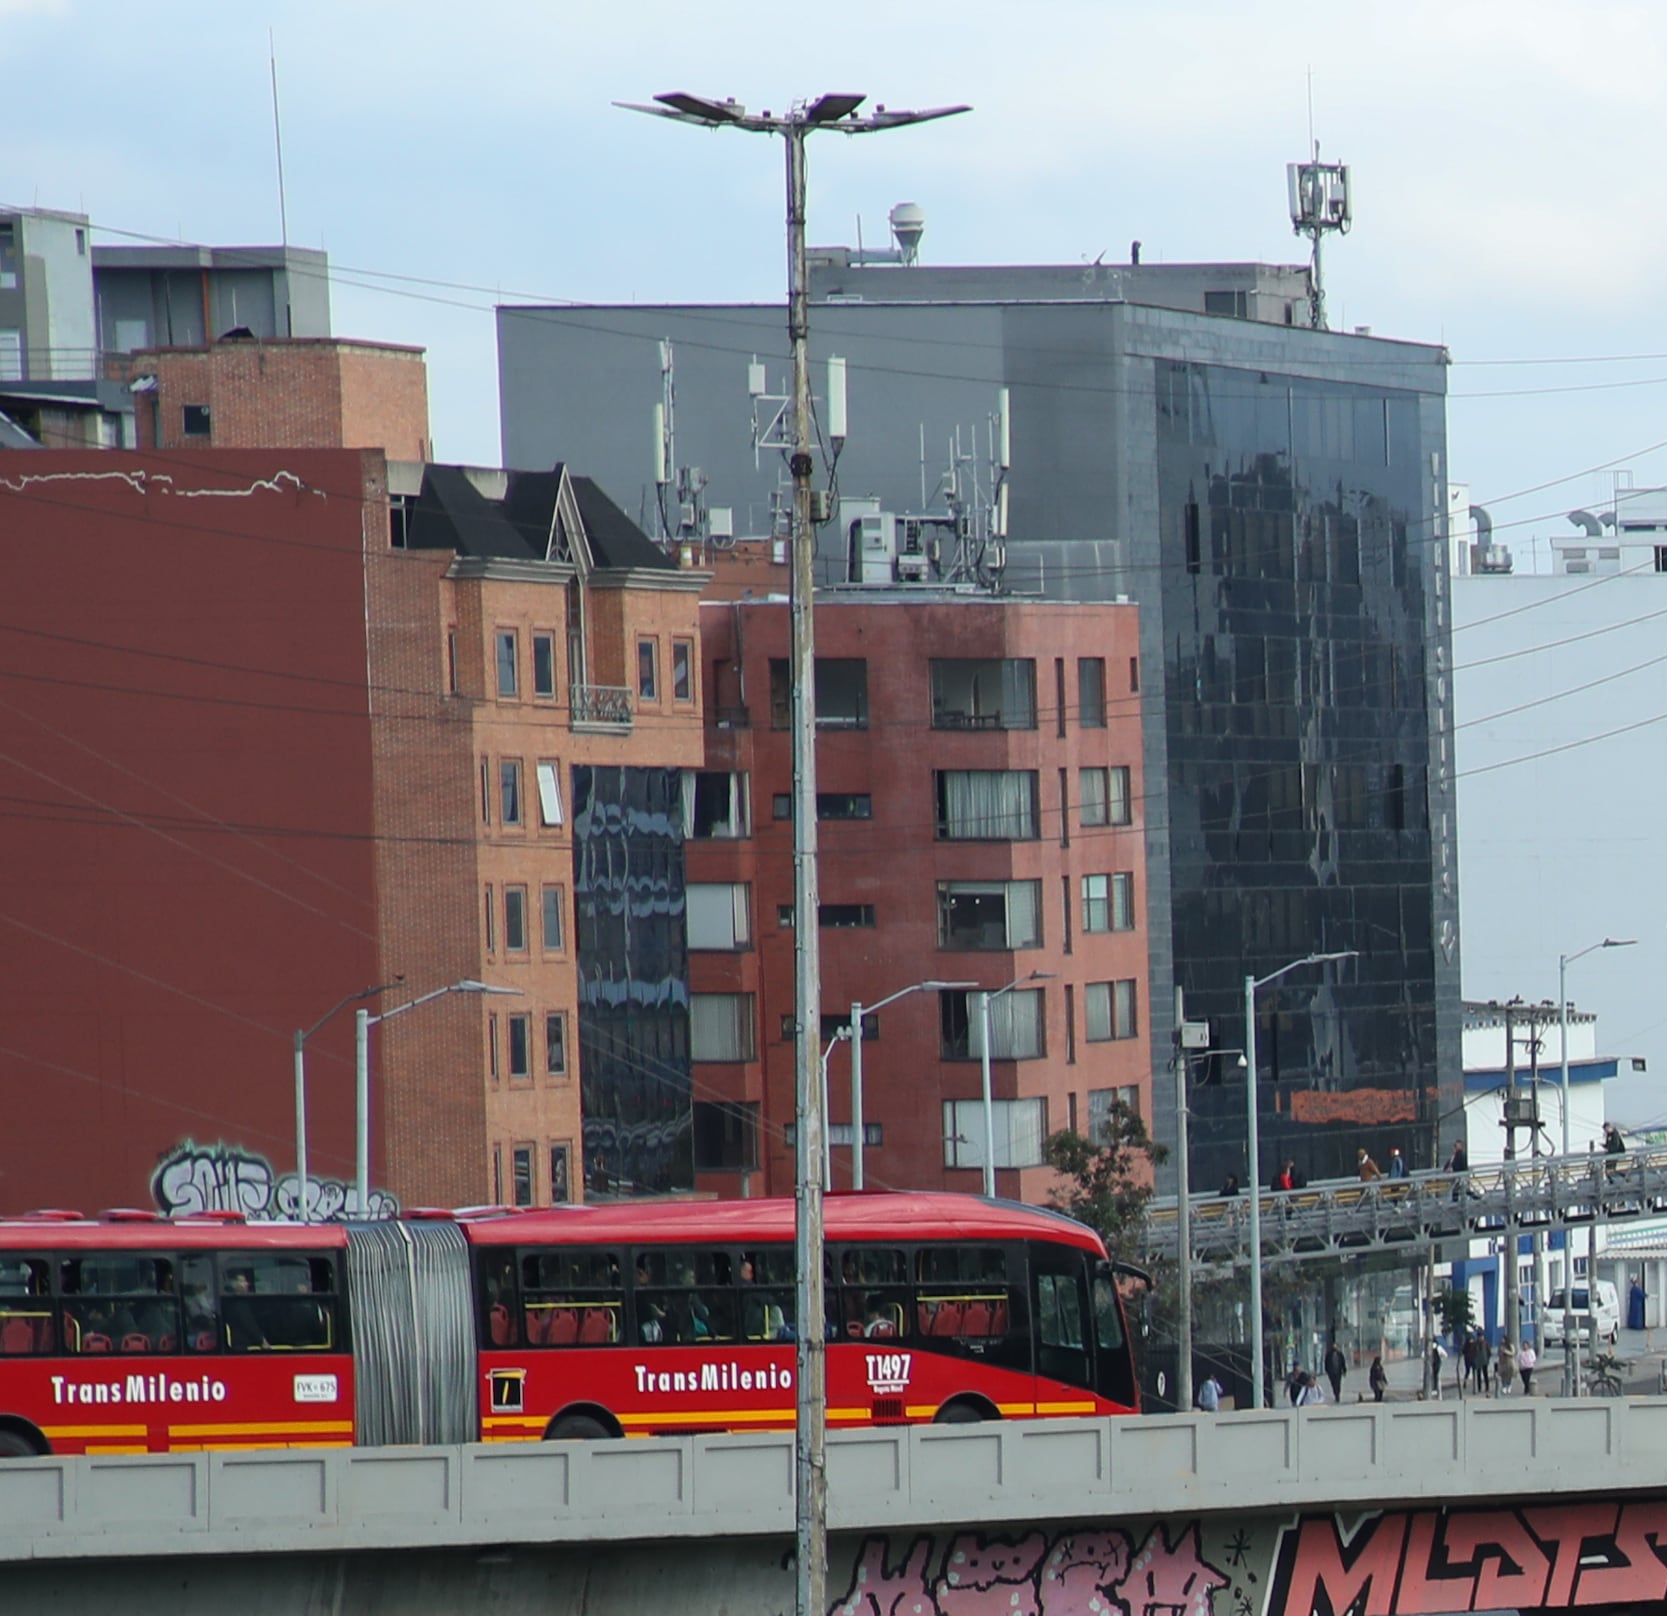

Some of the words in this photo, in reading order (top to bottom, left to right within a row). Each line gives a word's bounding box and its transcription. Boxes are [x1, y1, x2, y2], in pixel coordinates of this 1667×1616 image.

[634, 1362, 793, 1393] TransMilenio
[865, 1353, 912, 1382] T1497
[51, 1372, 226, 1405] TransMilenio
